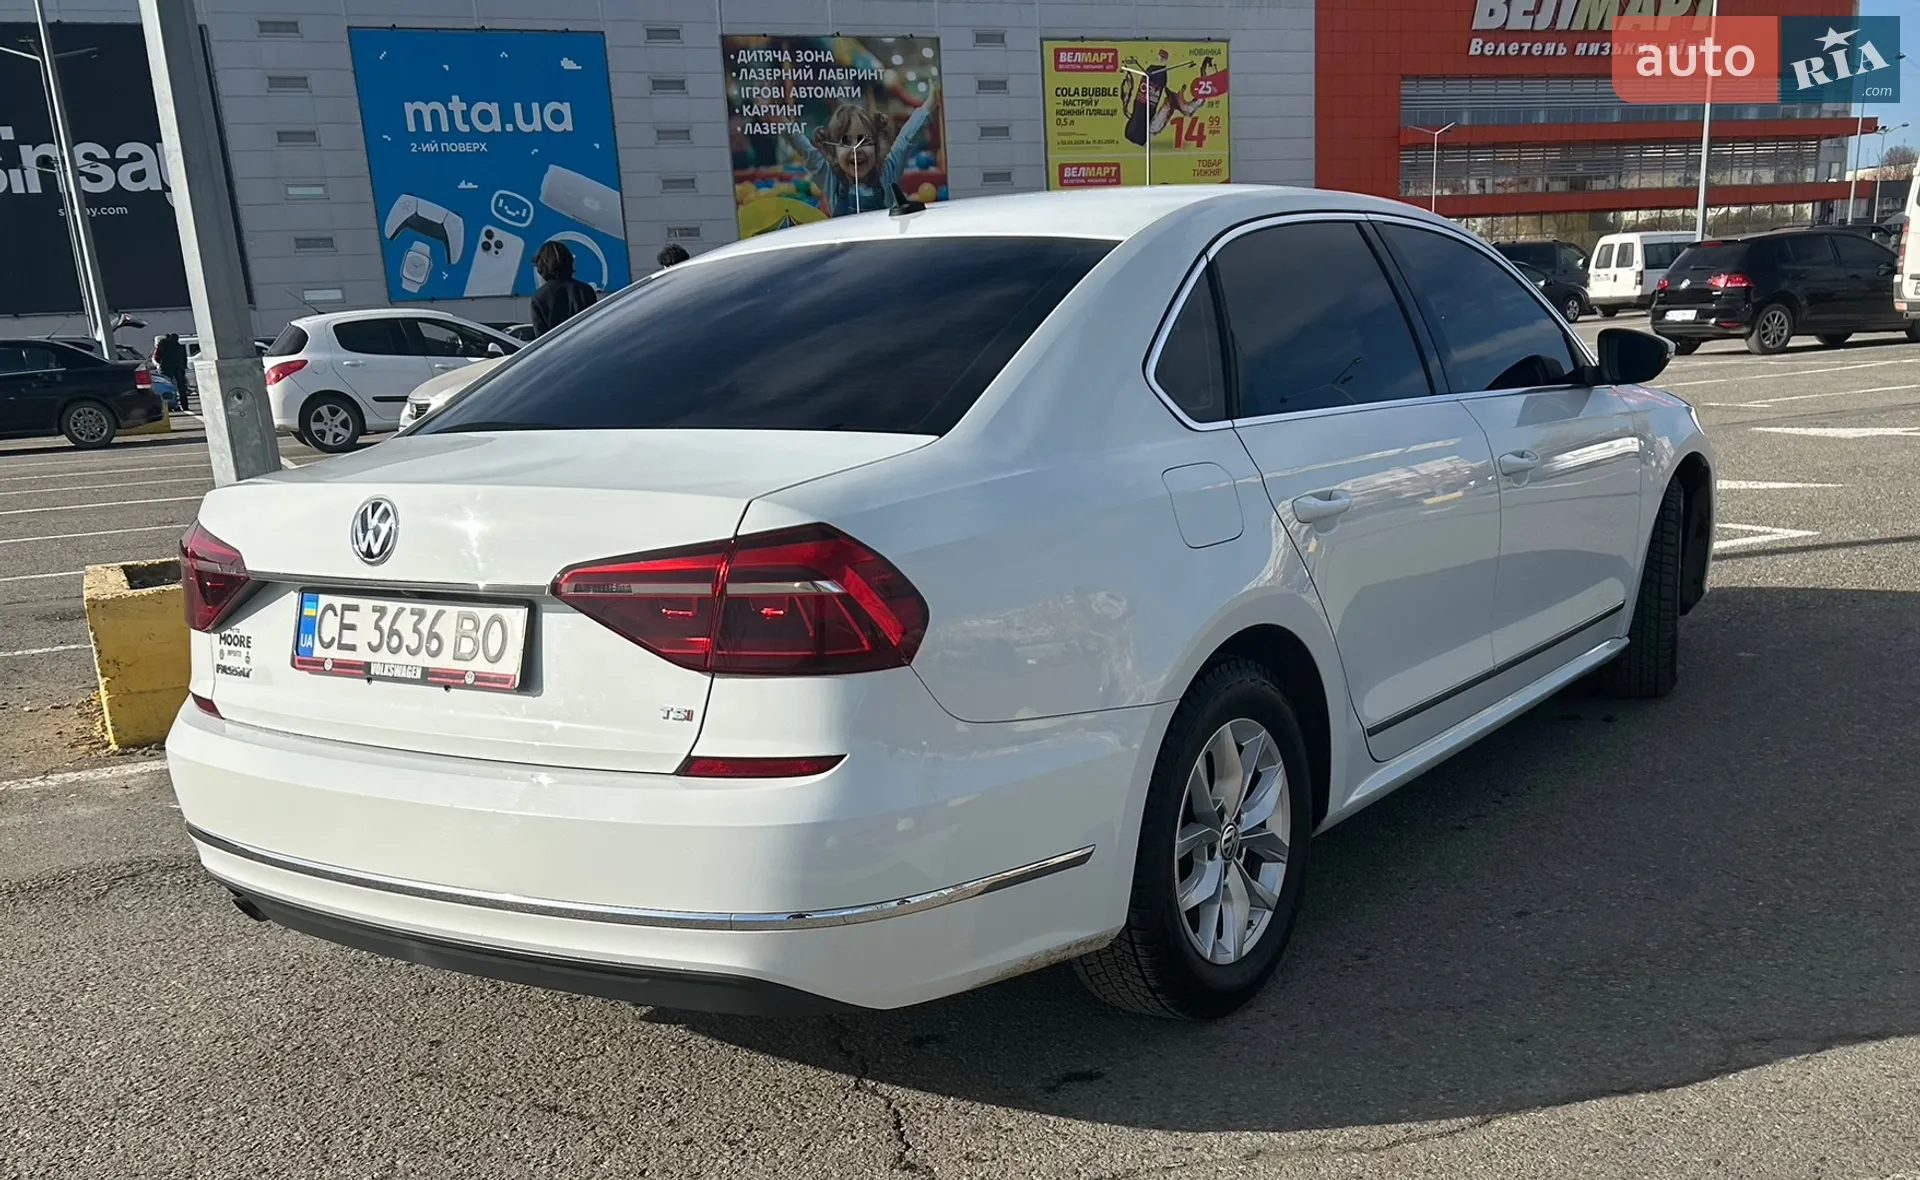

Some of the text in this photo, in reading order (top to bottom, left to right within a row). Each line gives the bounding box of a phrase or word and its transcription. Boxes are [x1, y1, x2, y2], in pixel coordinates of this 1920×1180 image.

[1469, 38, 1567, 56] Велетень
[737, 50, 834, 63] ДИТЯЧА ЗОНА
[1059, 52, 1114, 63] ВЕЛМАРТ
[739, 65, 885, 80] ЛАЗЕРНИЙ ЛАБІРИНТ
[741, 86, 861, 98] ІГРОВІ АВТОМАТИ
[1055, 87, 1119, 97] COLA BUBBLE
[404, 95, 573, 132] mta.ua
[742, 105, 804, 116] КАРТИНГ
[1056, 118, 1068, 127] 0,5
[1208, 116, 1220, 126] 99
[744, 122, 807, 135] ЛАЗЕРТАГ
[1171, 116, 1206, 148] 14
[410, 141, 488, 152] 2-ИЙ ПОВЕРХ
[1197, 159, 1222, 168] ТОВАР
[1064, 167, 1117, 177] ВЕЛМАРТ
[317, 602, 360, 651] CE
[367, 604, 446, 658] 3636
[219, 632, 252, 649] MOORE
[300, 633, 313, 648] UA
[370, 662, 422, 680] VOLKSWAGEN
